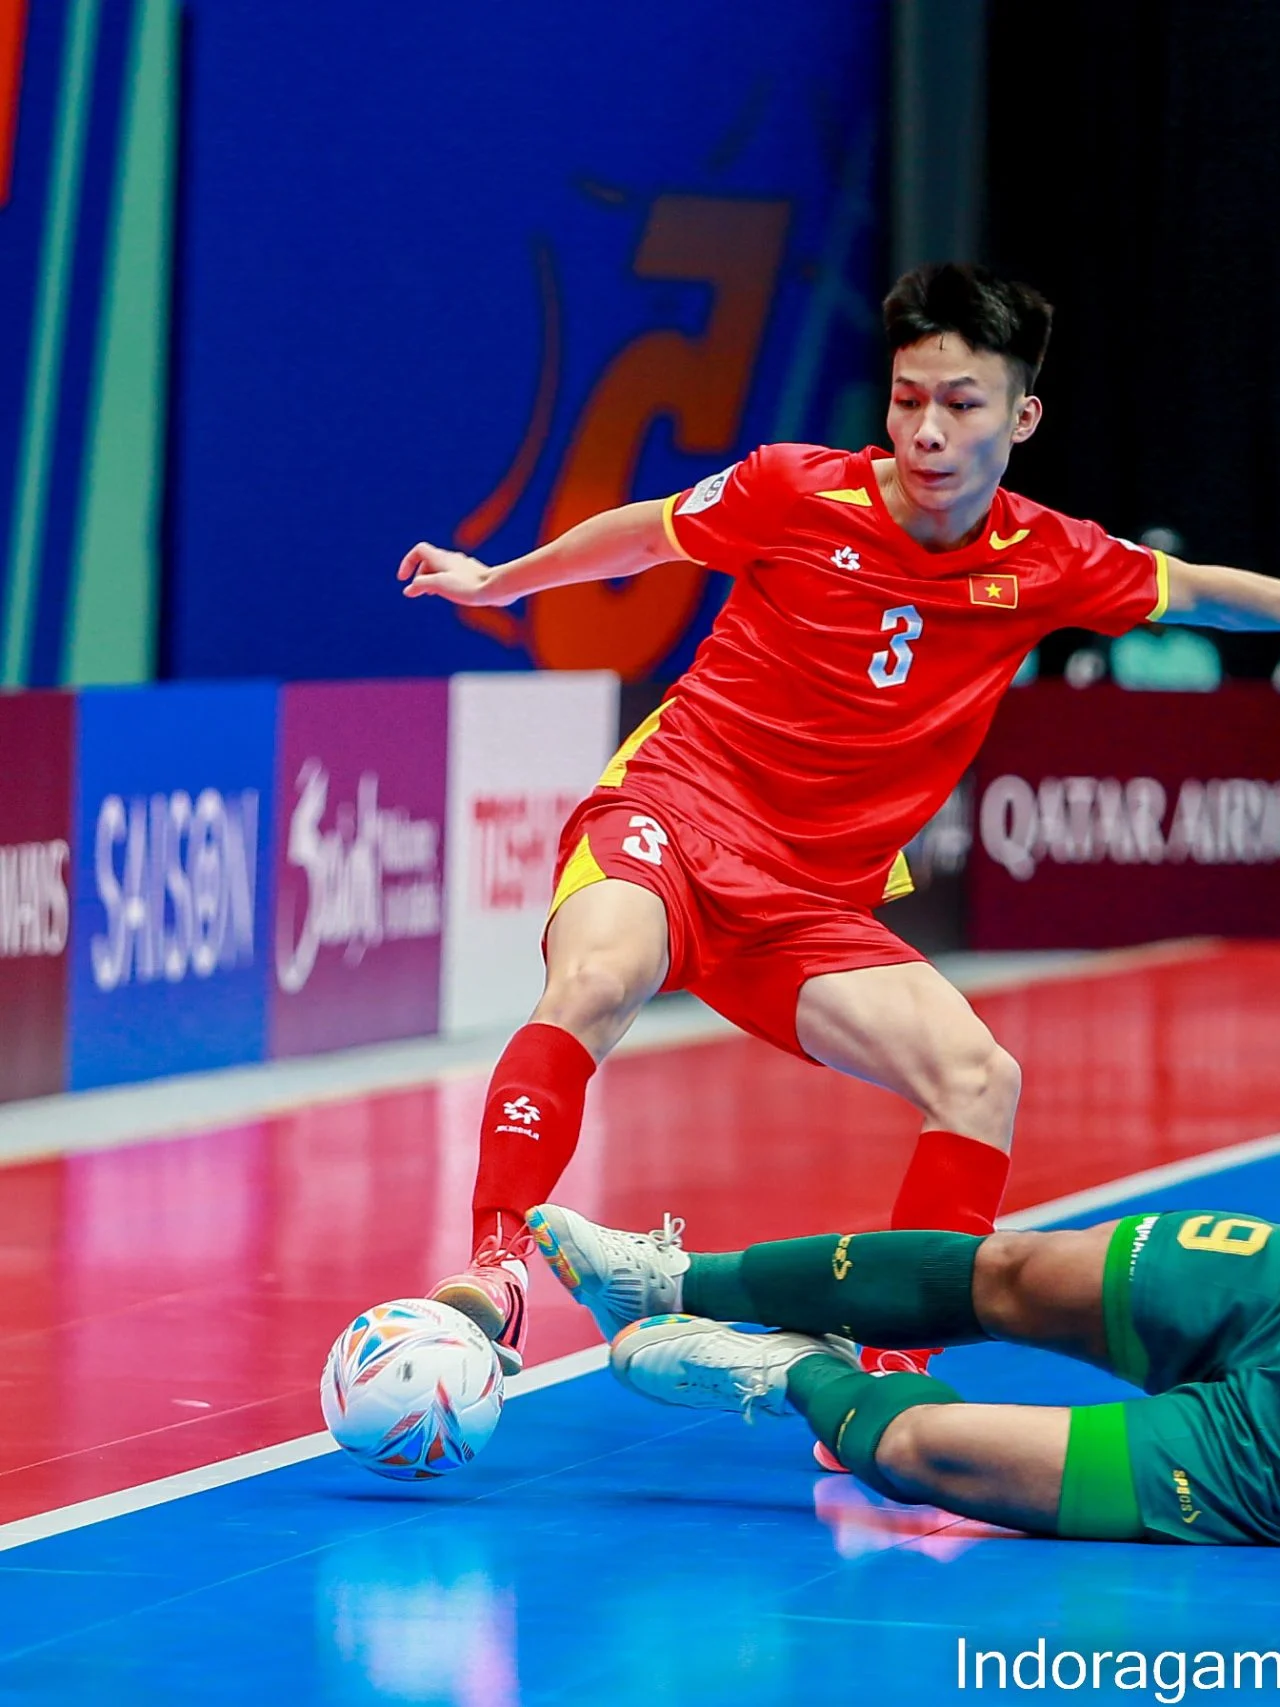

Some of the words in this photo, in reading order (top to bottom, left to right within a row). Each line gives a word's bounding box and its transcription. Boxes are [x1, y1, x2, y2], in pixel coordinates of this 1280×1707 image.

[867, 604, 924, 688] 3
[621, 815, 669, 867] 3
[980, 774, 1168, 881] QATAR
